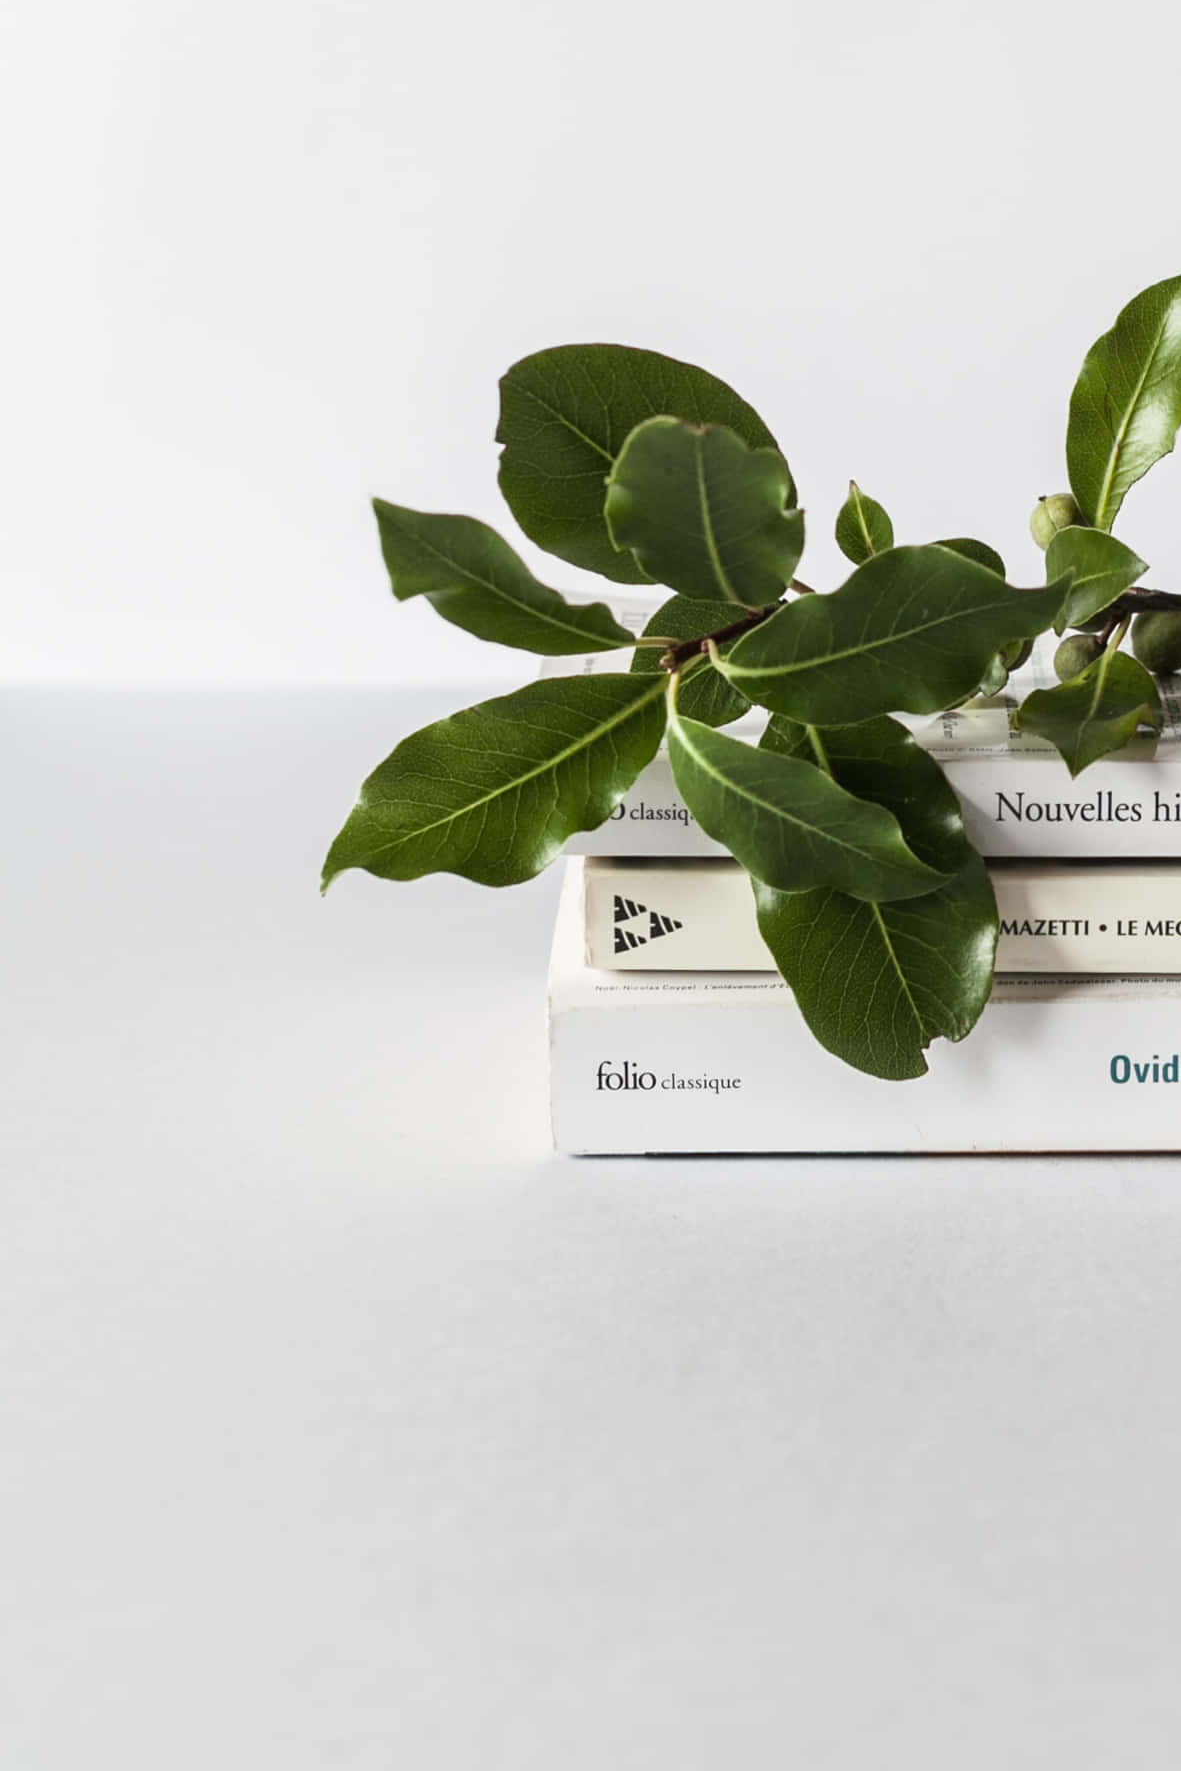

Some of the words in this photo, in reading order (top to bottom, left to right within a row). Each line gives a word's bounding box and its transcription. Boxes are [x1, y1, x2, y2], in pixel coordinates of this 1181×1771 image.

[629, 801, 693, 827] classiq
[994, 790, 1143, 823] Nouvelles
[999, 919, 1090, 937] MAZETTI
[1116, 919, 1139, 937] LE
[595, 1060, 658, 1092] folio
[660, 1071, 742, 1096] classique
